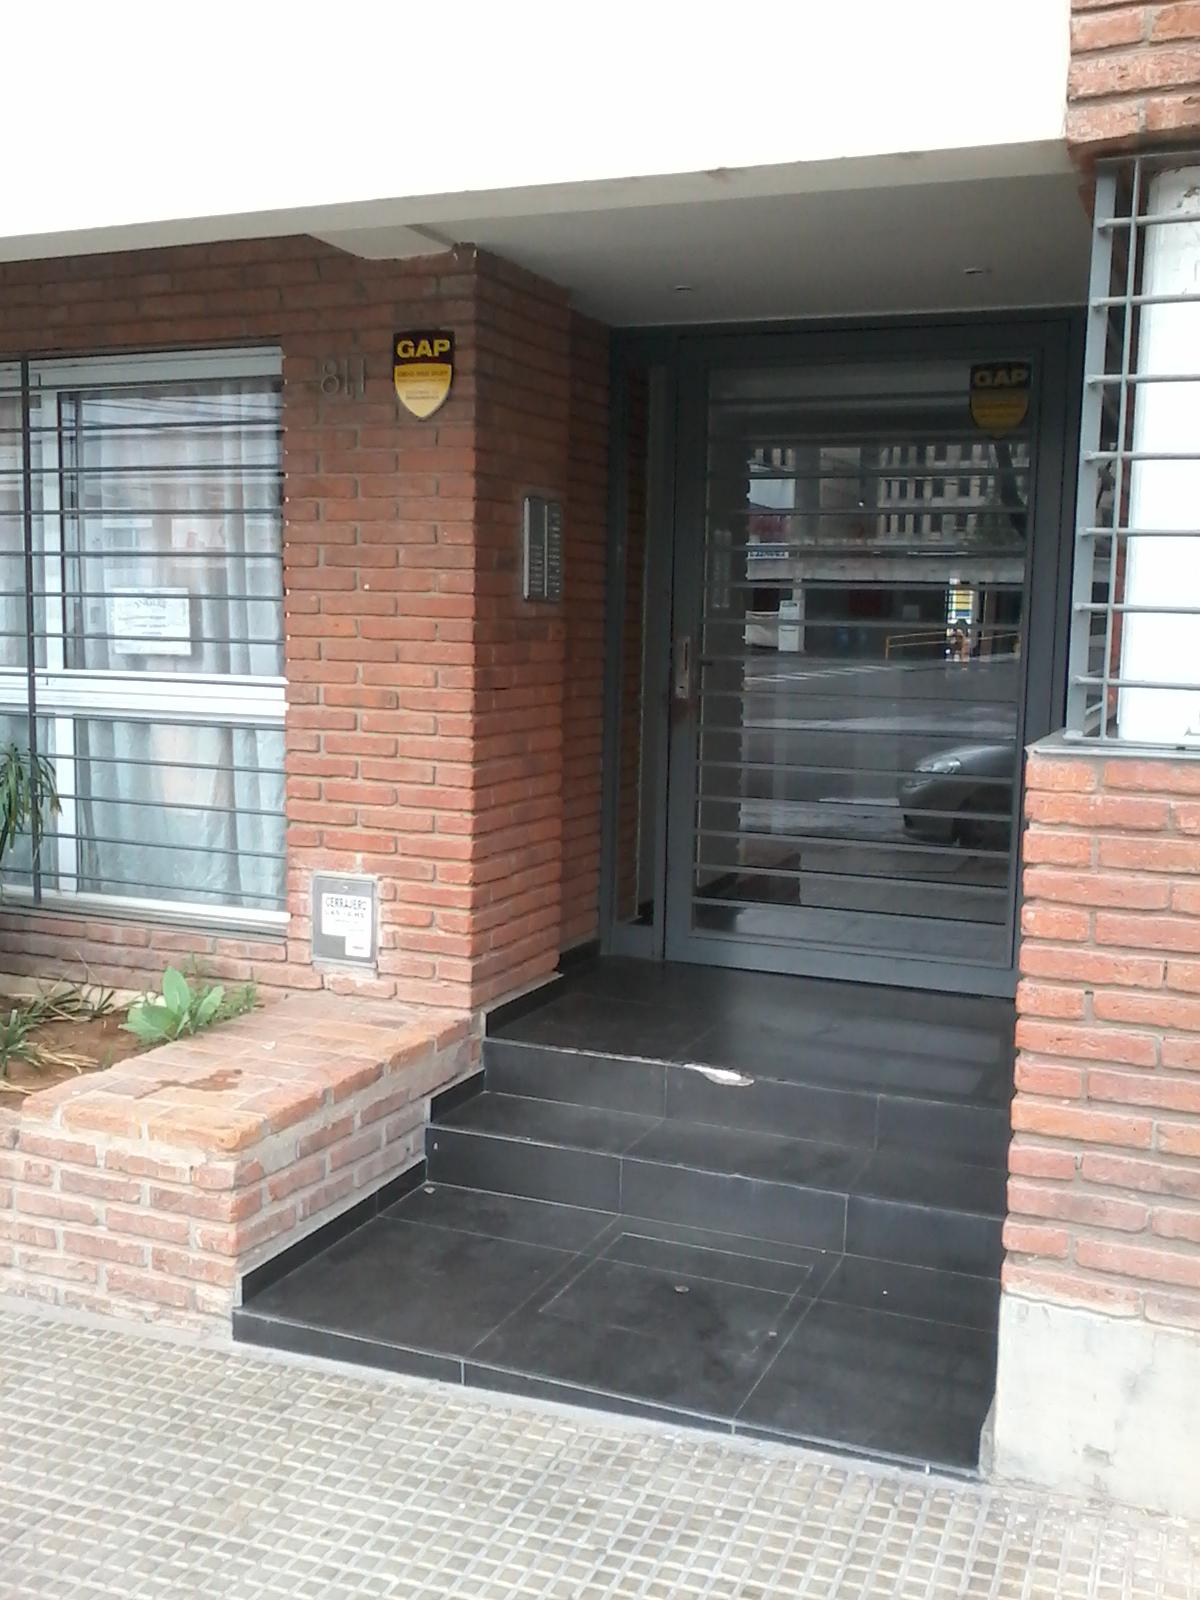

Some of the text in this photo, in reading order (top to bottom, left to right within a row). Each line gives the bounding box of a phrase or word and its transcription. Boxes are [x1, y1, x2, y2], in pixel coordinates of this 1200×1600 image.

[397, 339, 450, 358] GAP
[320, 358, 366, 394] 811
[975, 368, 1029, 387] GAP
